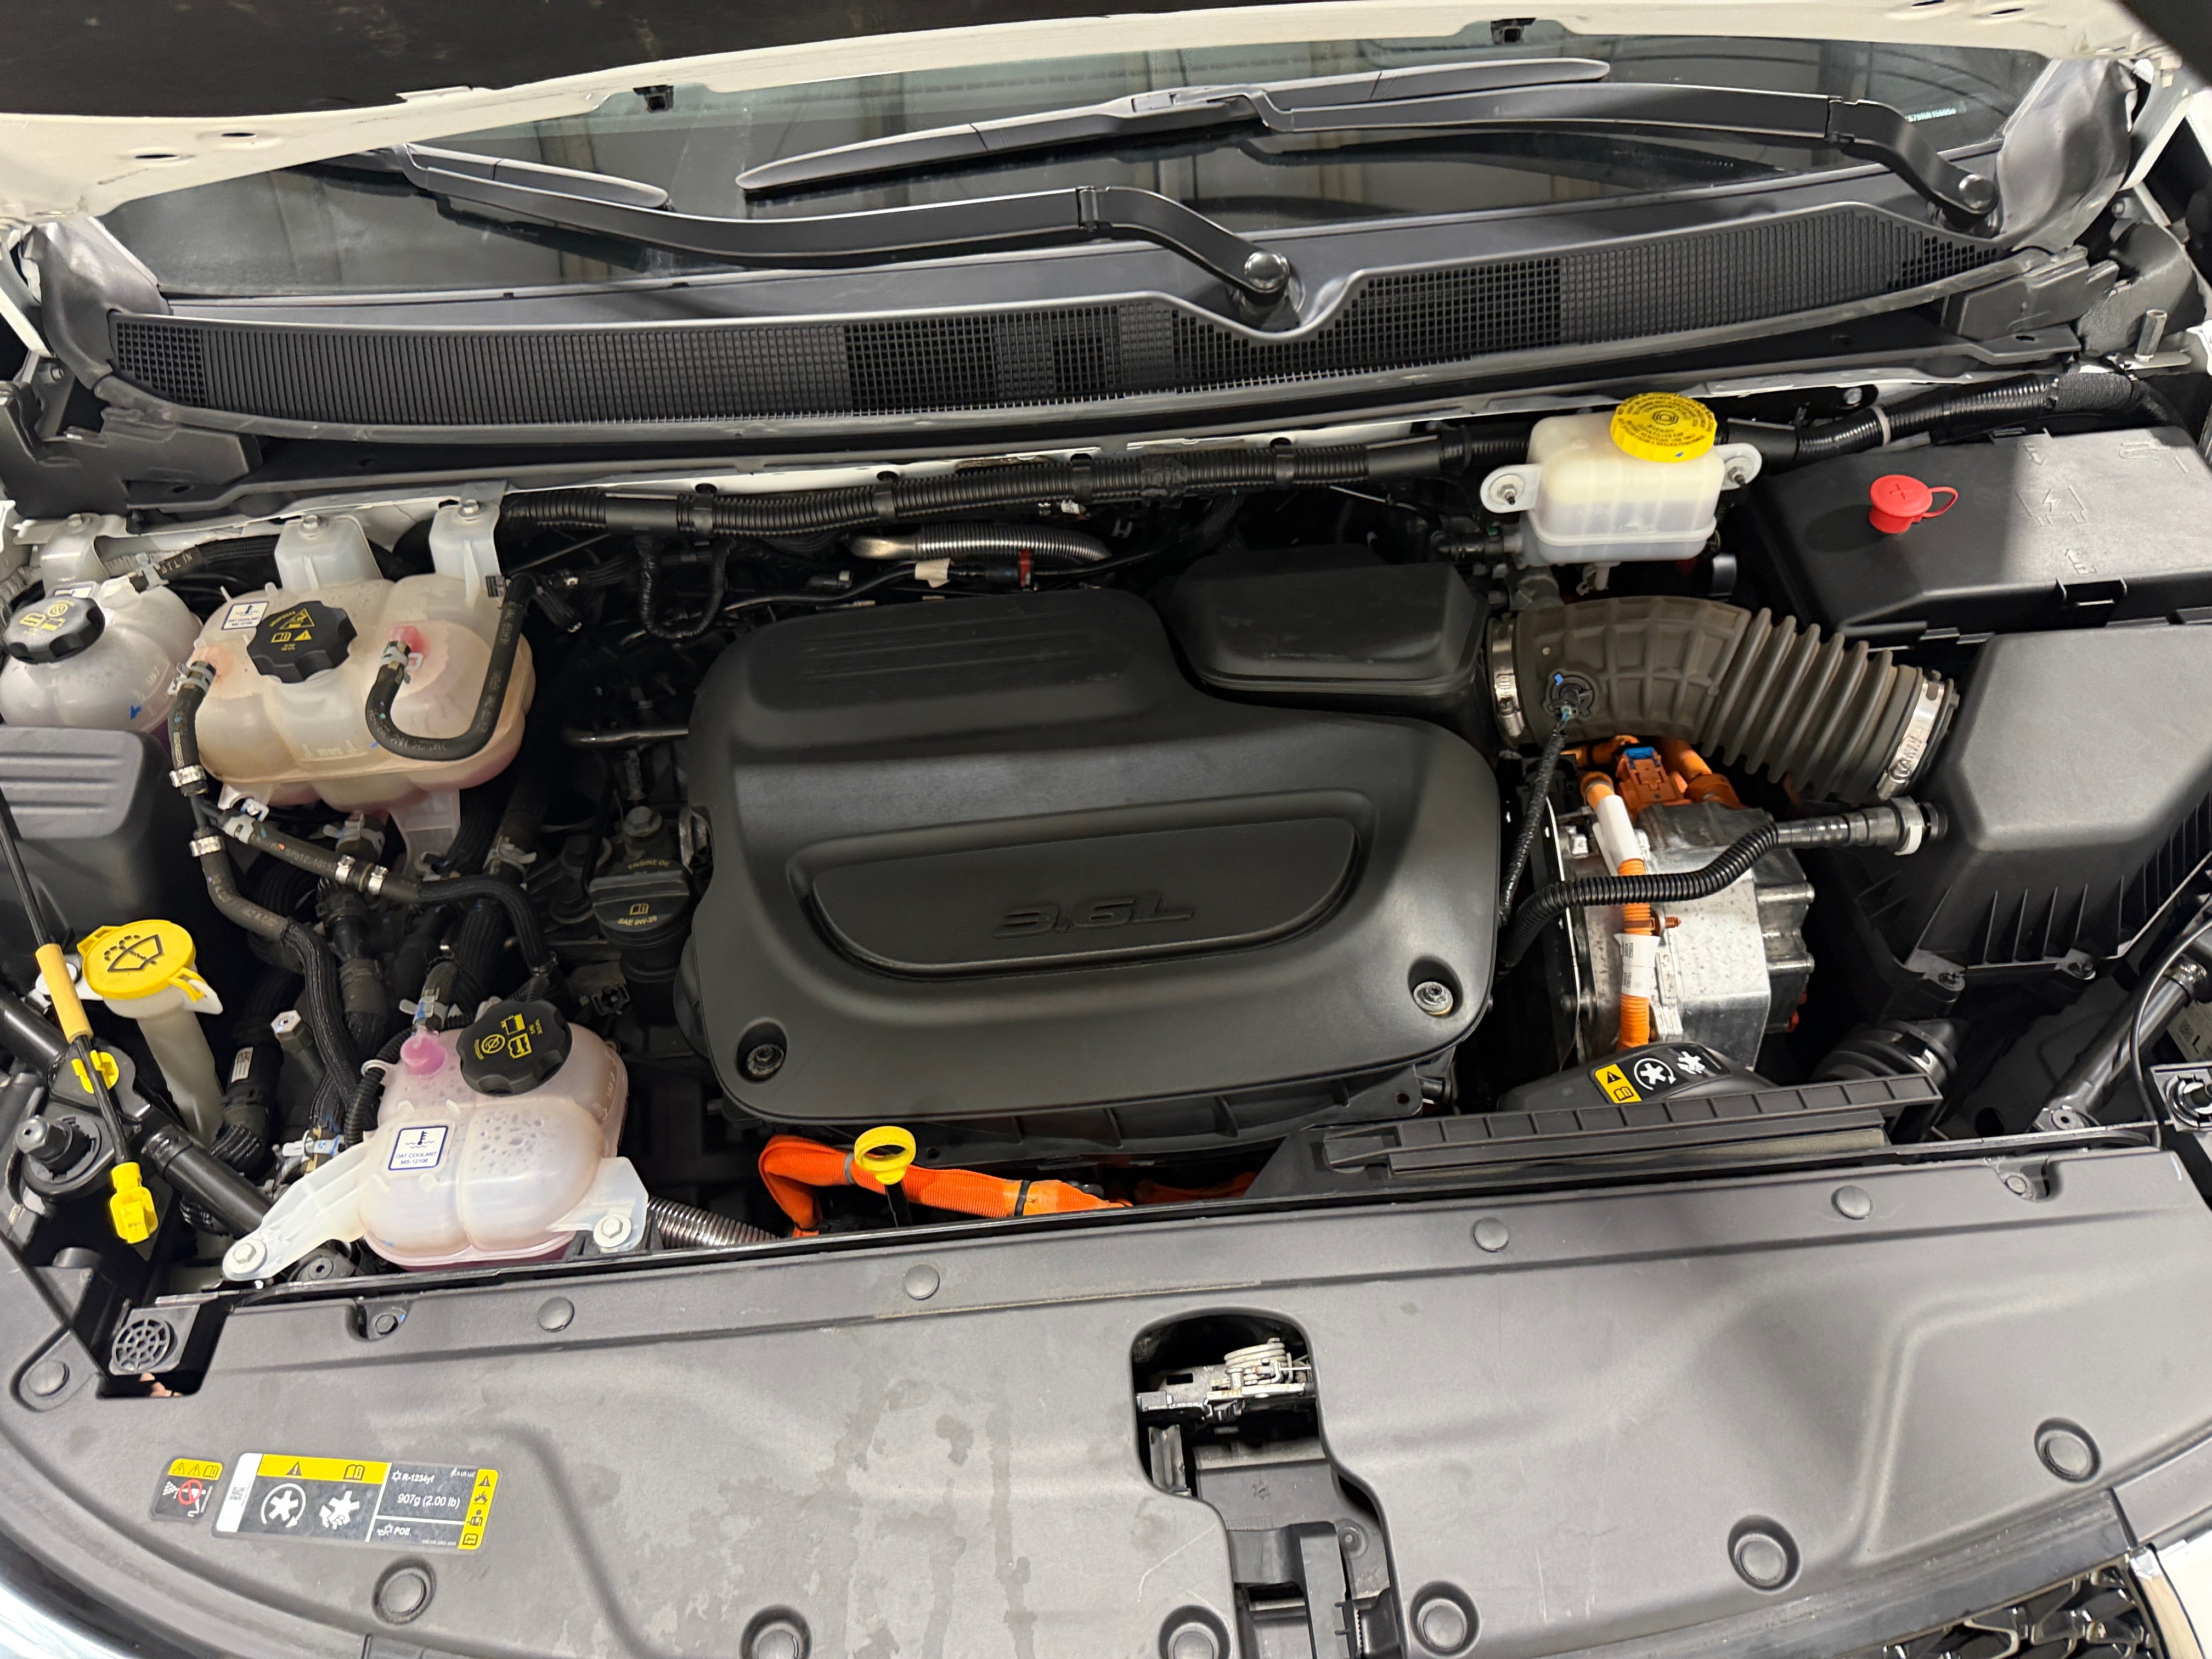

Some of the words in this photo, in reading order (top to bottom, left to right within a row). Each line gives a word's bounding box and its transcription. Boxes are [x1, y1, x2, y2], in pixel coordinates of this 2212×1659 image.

[994, 891, 1194, 939] 3.6L
[402, 1472, 436, 1485] R-1234yf
[397, 1493, 421, 1508] 907g
[422, 1494, 447, 1508] (2.00
[448, 1496, 461, 1509] lb)
[393, 1526, 411, 1537] POE
